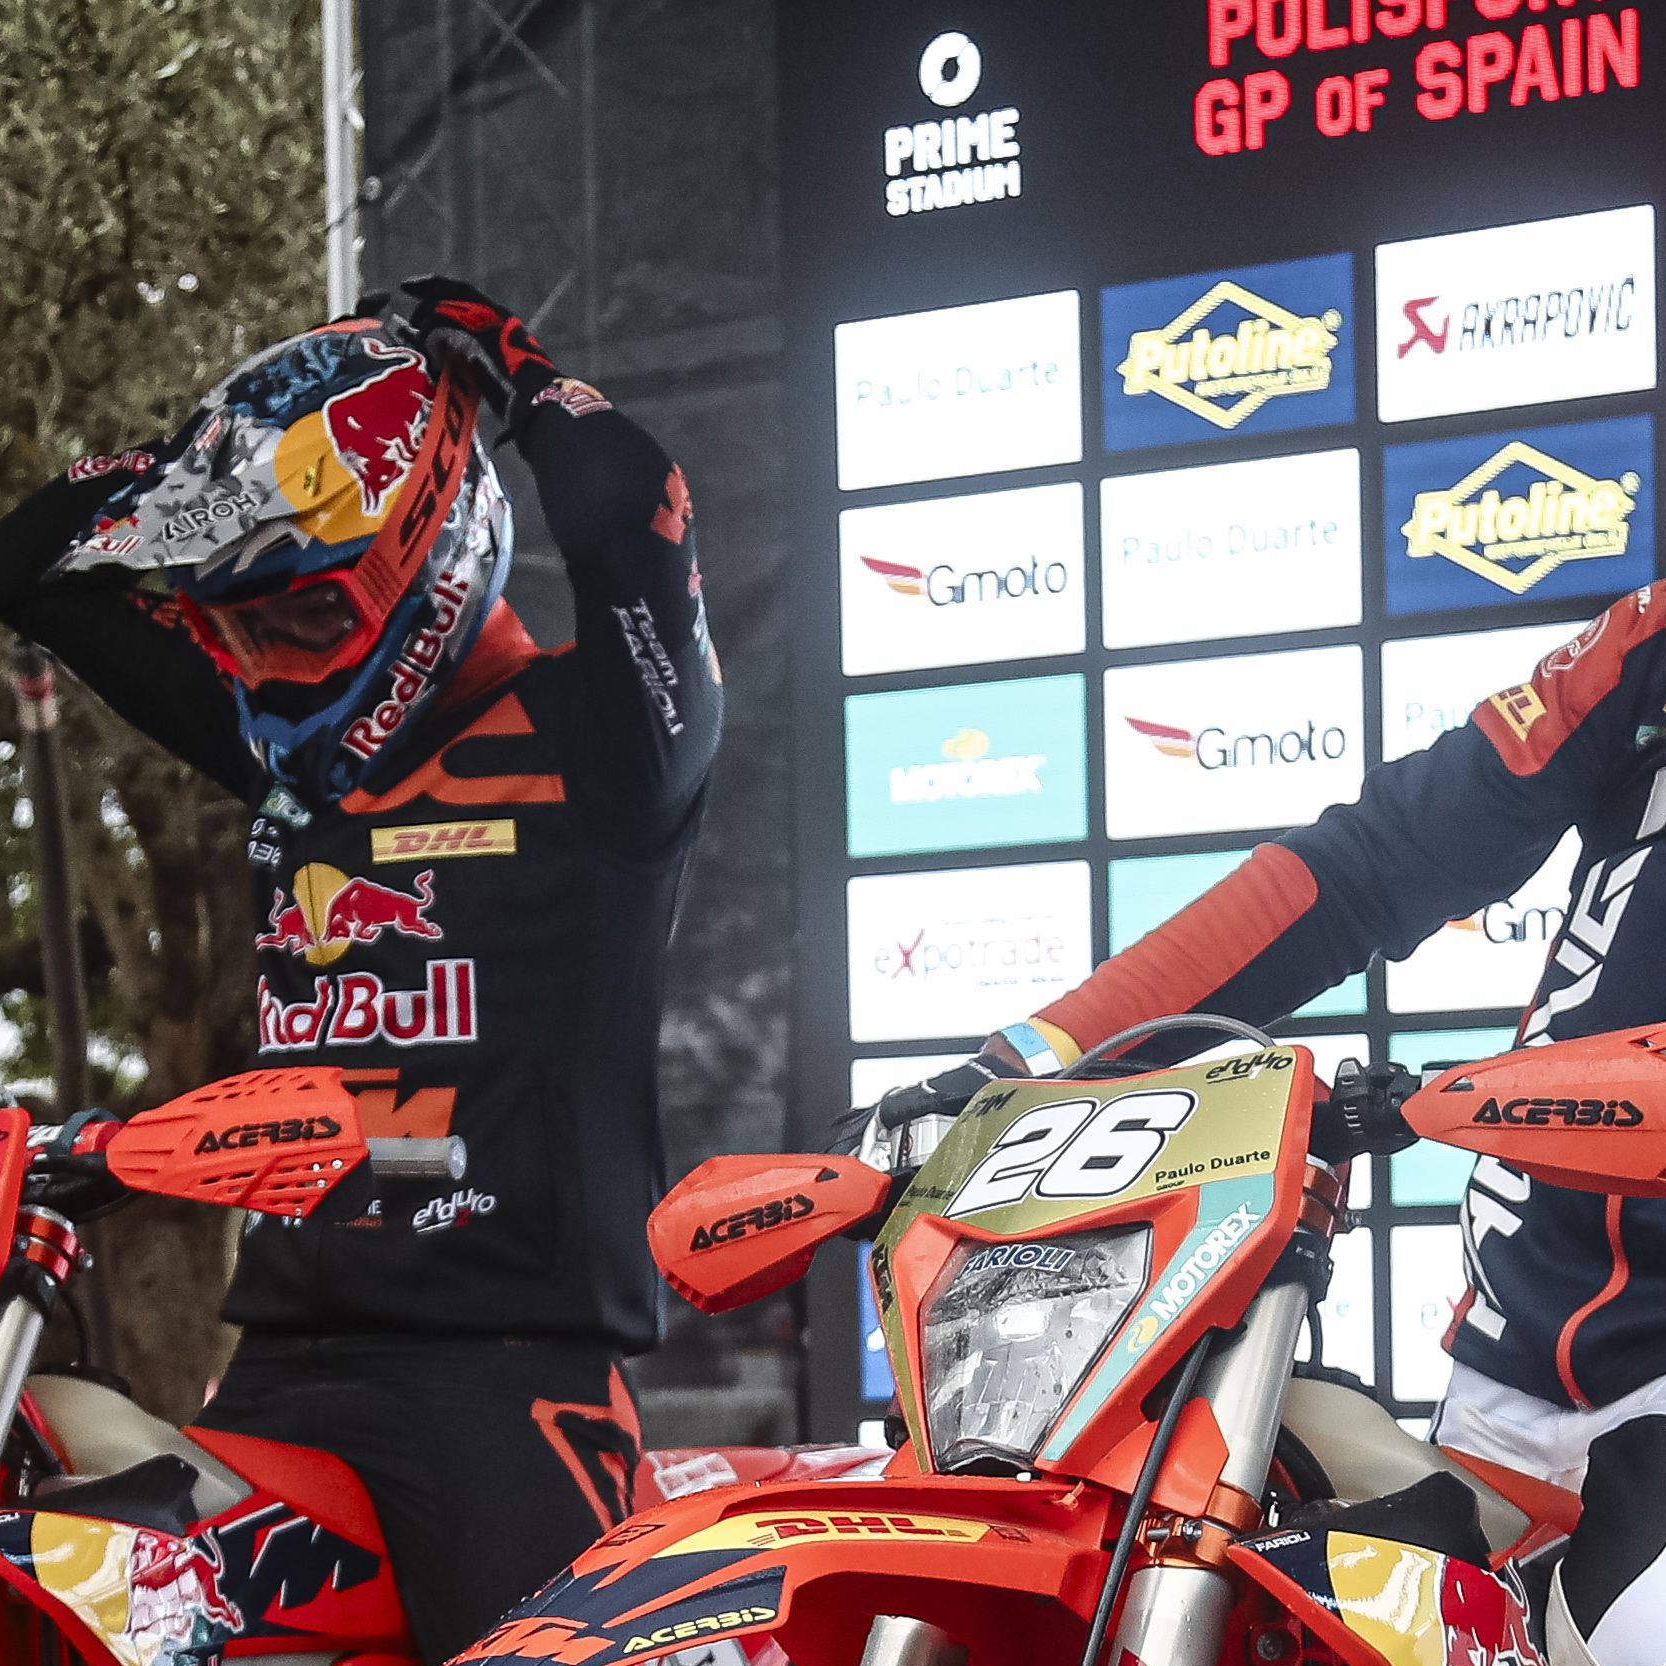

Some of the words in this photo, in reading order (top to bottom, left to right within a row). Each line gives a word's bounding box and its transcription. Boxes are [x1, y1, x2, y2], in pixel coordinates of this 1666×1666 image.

[1194, 70, 1290, 156] GP
[1315, 69, 1389, 137] OF
[1414, 8, 1640, 121] SPAIN
[885, 108, 1021, 177] PRIME
[886, 162, 1021, 217] STADIUM
[1130, 314, 1325, 384] Putoline
[163, 491, 259, 541] AIROH
[1416, 478, 1615, 545] Putoline
[1122, 530, 1211, 569] Paulo
[1228, 514, 1339, 555] Duarte
[927, 553, 1068, 608] Gmoto
[341, 663, 429, 760] Red
[1197, 719, 1347, 773] Gmoto
[394, 826, 495, 852] DHL
[326, 957, 478, 1045] Bull
[193, 1116, 343, 1156] ACERBIS
[1471, 1096, 1645, 1127] ACERBIS
[944, 1087, 1201, 1220] 26
[1154, 1161, 1205, 1184] Paulo
[1209, 1148, 1272, 1171] Duarte
[412, 1188, 497, 1226] enduro
[688, 1193, 815, 1253] ACERBIS
[963, 1244, 1076, 1274] FARIOLI
[1158, 1201, 1259, 1320] MOTOREX
[755, 1515, 945, 1540] DHL
[1255, 1529, 1311, 1553] FARIOLI
[621, 1606, 778, 1655] ACERBIS
